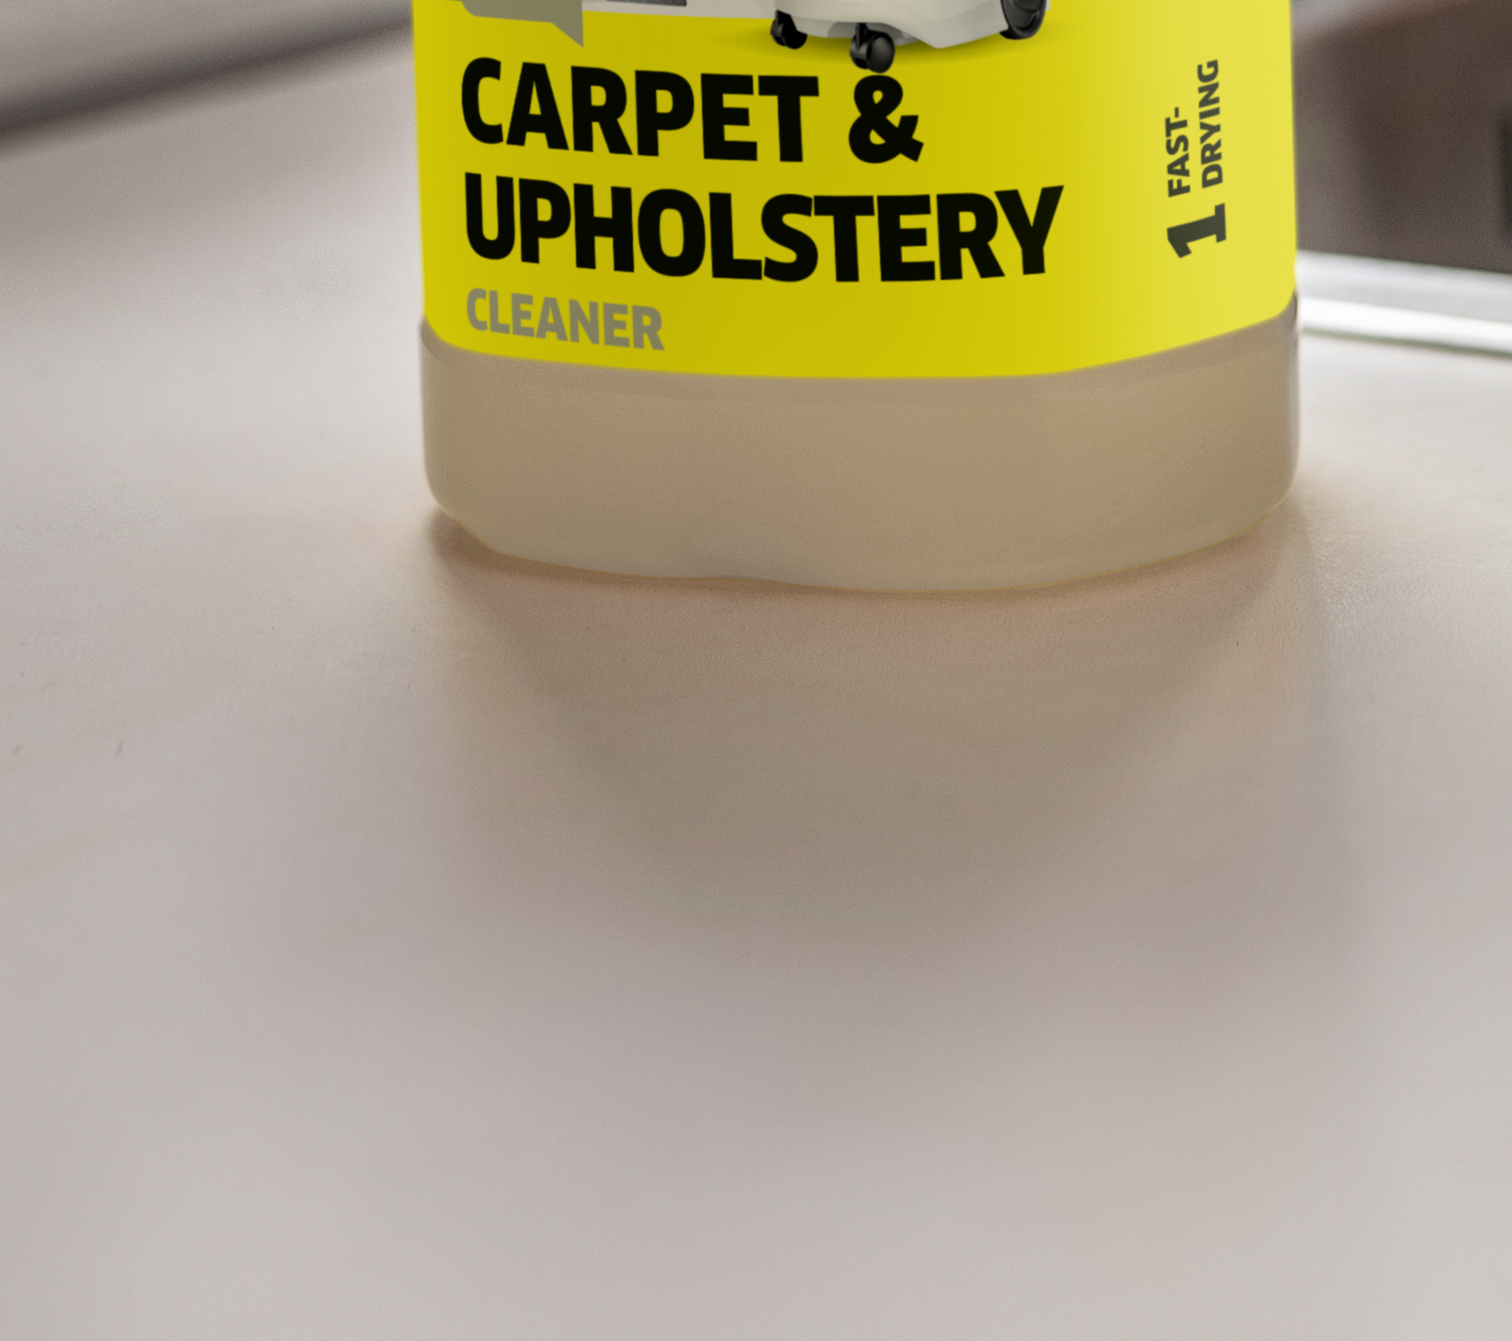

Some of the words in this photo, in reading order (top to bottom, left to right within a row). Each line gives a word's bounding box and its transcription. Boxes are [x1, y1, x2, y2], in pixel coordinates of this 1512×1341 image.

[461, 56, 819, 163] CARPET
[848, 74, 924, 165] &
[1164, 106, 1191, 198] FAST-
[1196, 59, 1224, 189] DRYING
[464, 172, 1064, 283] UPHOLSTERY
[1166, 202, 1228, 259] 1
[466, 287, 665, 352] CLEANER
